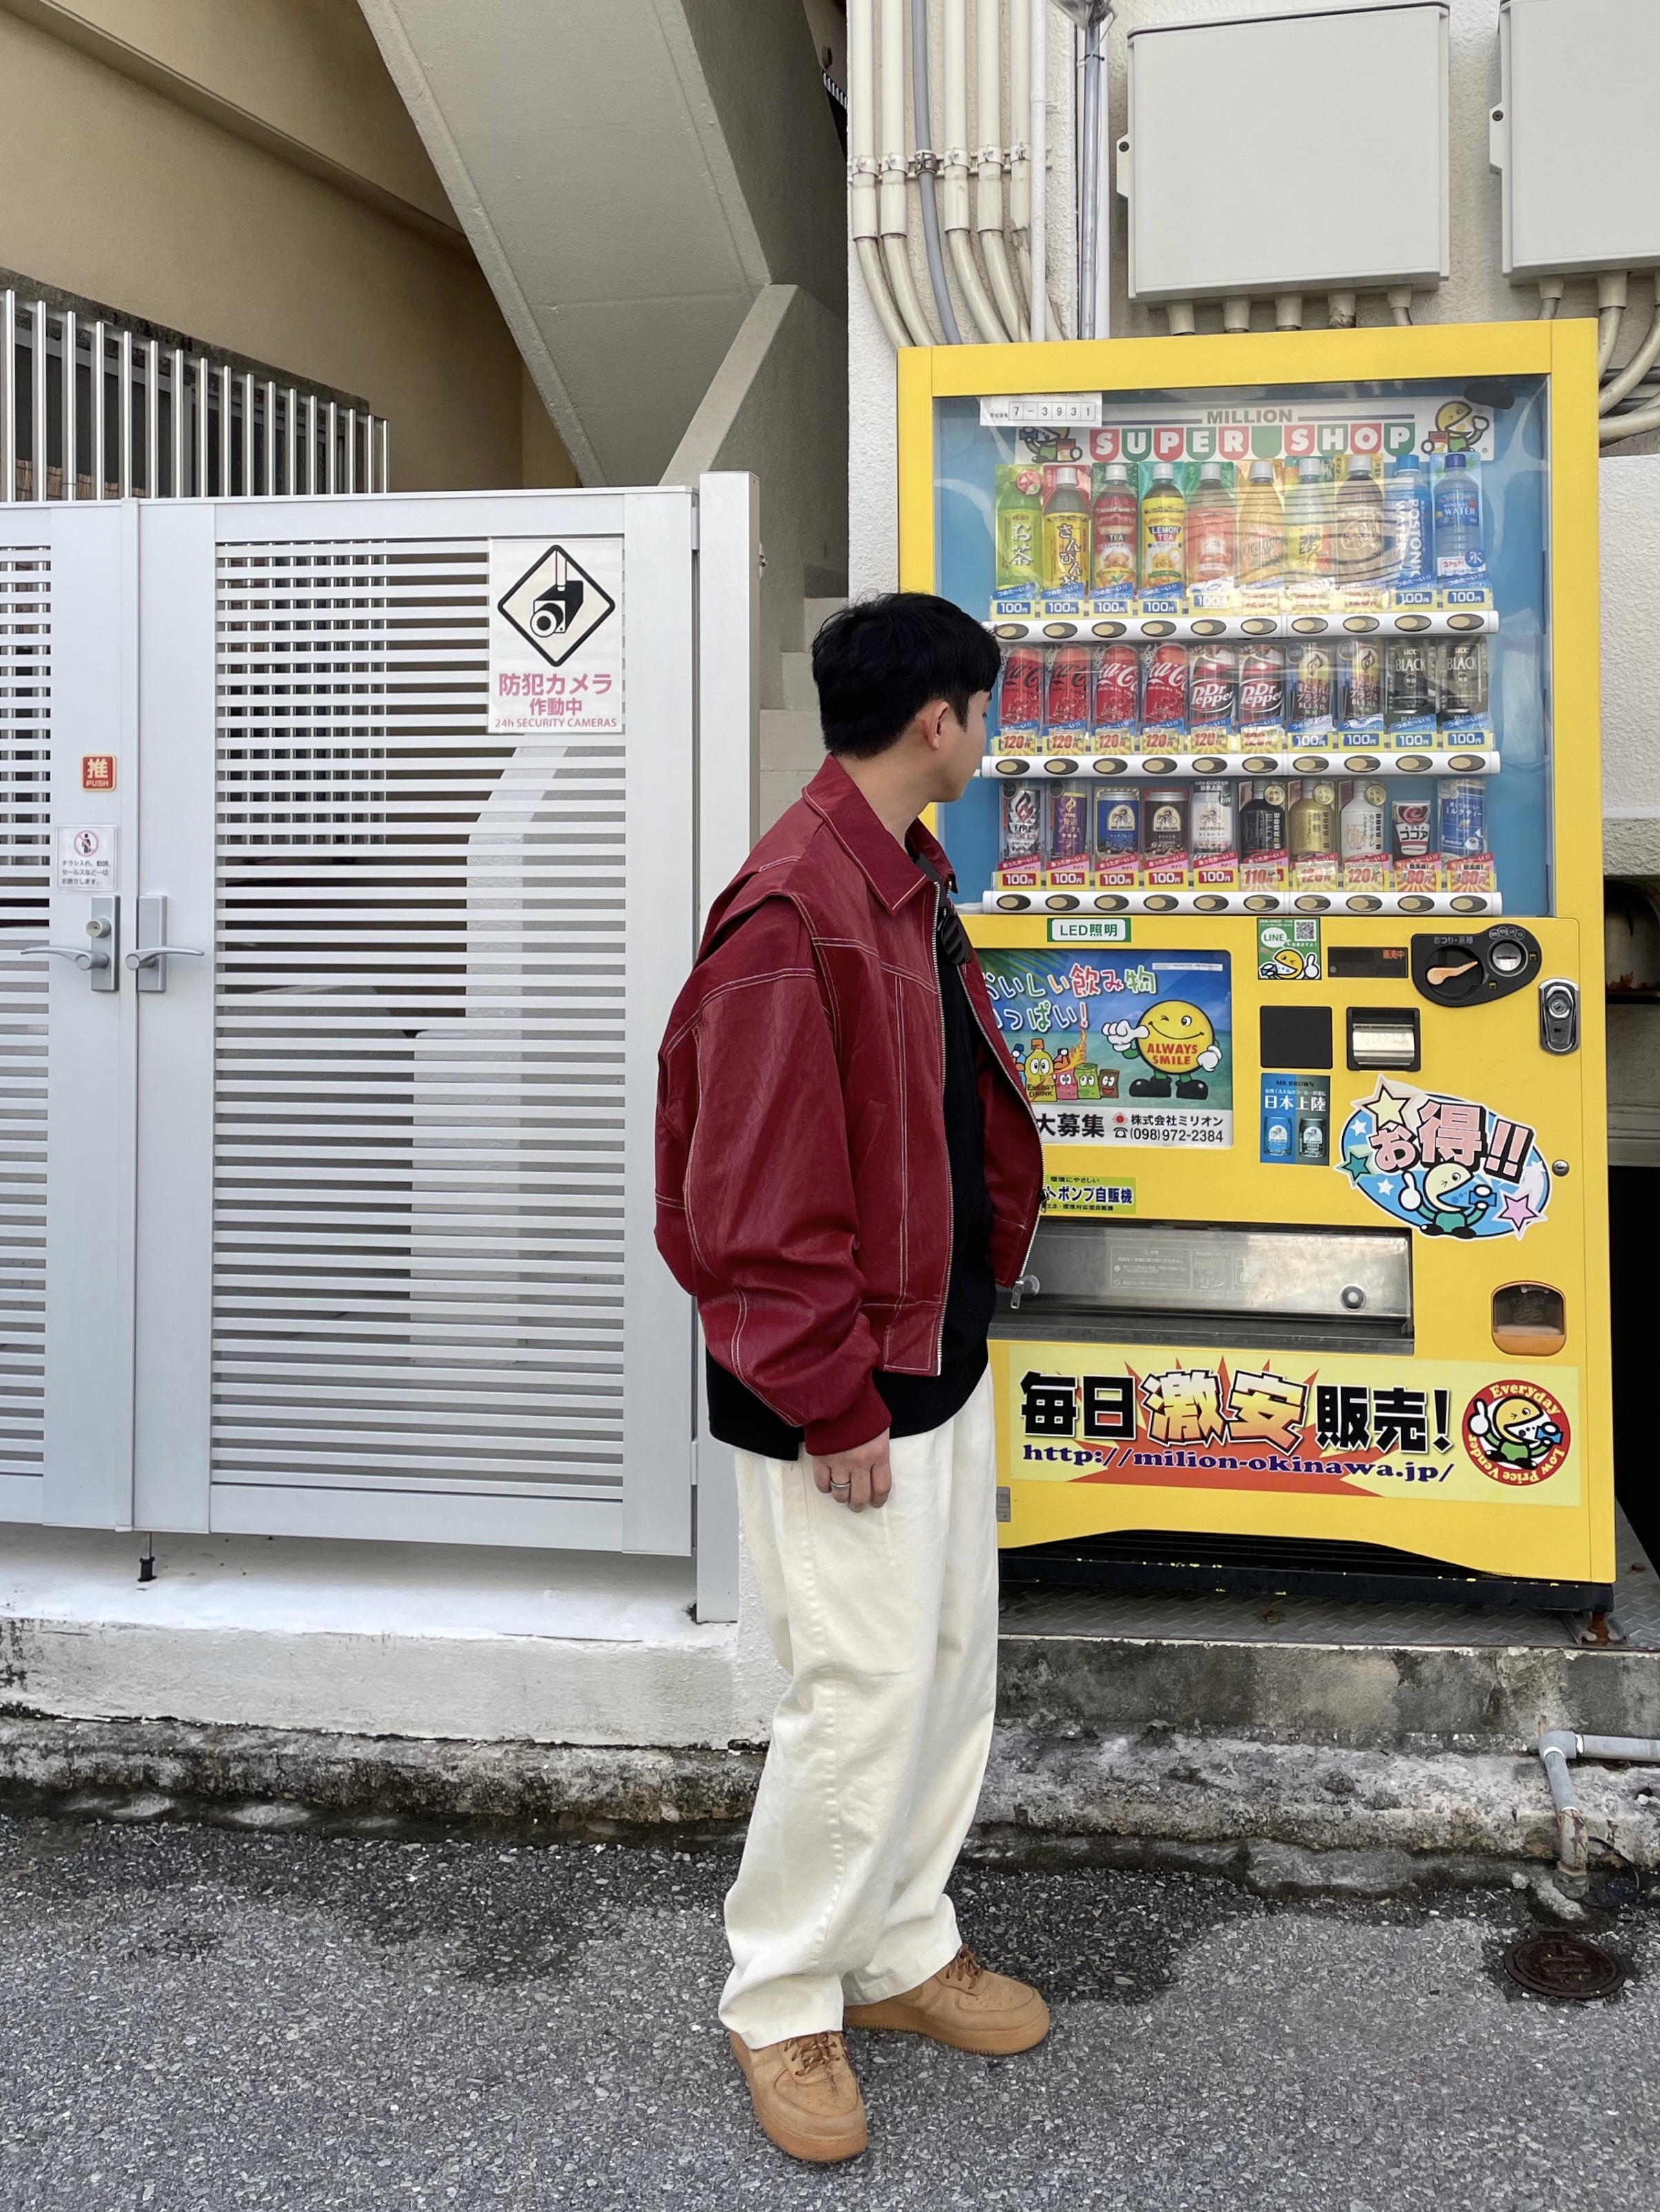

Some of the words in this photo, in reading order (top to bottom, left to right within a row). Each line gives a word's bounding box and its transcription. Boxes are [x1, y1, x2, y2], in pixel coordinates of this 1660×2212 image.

[1207, 409, 1293, 424] MILLION
[1095, 429, 1244, 456] SUPER
[1291, 426, 1410, 452] SHOP
[1444, 507, 1476, 516] WATER
[1009, 524, 1033, 566] お茶
[1399, 593, 1430, 605] 100円
[1452, 592, 1481, 603] 100円
[1000, 602, 1028, 613] 100円
[1049, 602, 1076, 613] 100円
[1097, 602, 1125, 613] 100円
[1146, 602, 1175, 613] 100円
[1395, 658, 1426, 672] BLACK
[1448, 657, 1478, 671] BLACK
[498, 673, 613, 697] 防犯カメラ
[1208, 683, 1228, 694] Dr
[1258, 682, 1277, 694] Dr
[1191, 684, 1234, 708] Pepper
[1240, 684, 1282, 707] Pepper
[529, 698, 583, 716] 作動中
[495, 718, 514, 728] 24h
[516, 718, 565, 728] SECURITY
[567, 718, 618, 728] CAMERAS
[1003, 735, 1031, 749] 120円
[1051, 734, 1079, 749] 120円
[1098, 733, 1126, 749] 120円
[1146, 733, 1173, 748] 120円
[1193, 731, 1222, 747] 120円
[1295, 735, 1326, 746] 100円
[1346, 734, 1377, 745] 100円
[1399, 735, 1430, 747] 100円
[1451, 733, 1481, 744] 100円
[87, 758, 109, 779] 推
[85, 780, 110, 788] PUSH
[1399, 829, 1428, 840] ココア
[1005, 874, 1033, 885] 100円
[1053, 873, 1082, 884] 100円
[1103, 874, 1131, 885] 100円
[1152, 873, 1181, 884] 100円
[1202, 871, 1231, 882] 100円
[1244, 869, 1273, 884] 110円
[1348, 869, 1378, 884] 120円
[1406, 871, 1431, 884] 80円
[1460, 871, 1486, 885] 80円
[1060, 923, 1118, 937] LED照明
[1264, 933, 1285, 942] LINE
[1382, 949, 1405, 960] 販売中
[1146, 1043, 1198, 1055] ALWAYS
[1152, 1055, 1191, 1066] SMILE
[1264, 1095, 1326, 1112] 日本上陸
[1036, 1113, 1105, 1138] 大募集
[1131, 1113, 1224, 1127] 株式会社ミリオン
[1129, 1128, 1224, 1143] (098)972-2384
[1370, 1099, 1534, 1184] お得!!
[1488, 1383, 1561, 1414] Everyday
[1020, 1368, 1453, 1456] 毎日激安販売!
[1023, 1443, 1455, 1483] http://milion-okinawa.jp/
[1468, 1434, 1500, 1479] Vender
[1541, 1448, 1566, 1474] Low
[1501, 1470, 1540, 1485] Price
